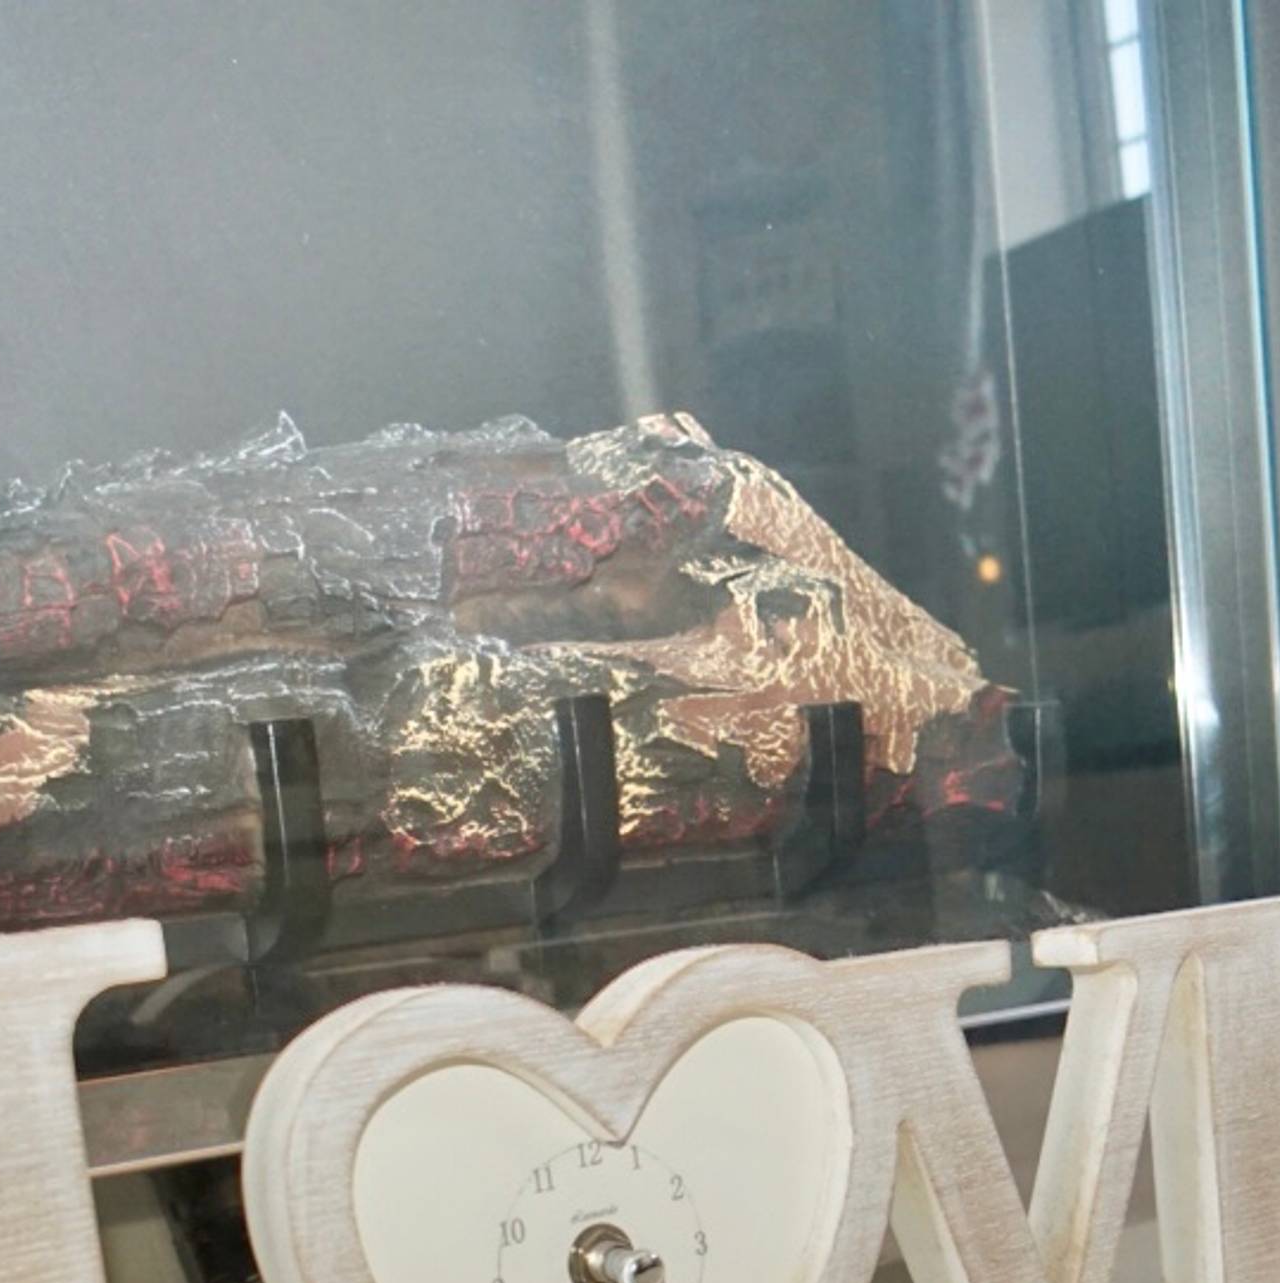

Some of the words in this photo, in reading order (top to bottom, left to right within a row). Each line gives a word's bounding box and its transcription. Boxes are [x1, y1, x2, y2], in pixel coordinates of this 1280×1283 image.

[577, 1140, 602, 1168] 12
[631, 1145, 641, 1170] 1
[532, 1165, 555, 1194] 11
[670, 1175, 684, 1200] 2
[500, 1217, 526, 1247] 10
[694, 1231, 708, 1256] 3
